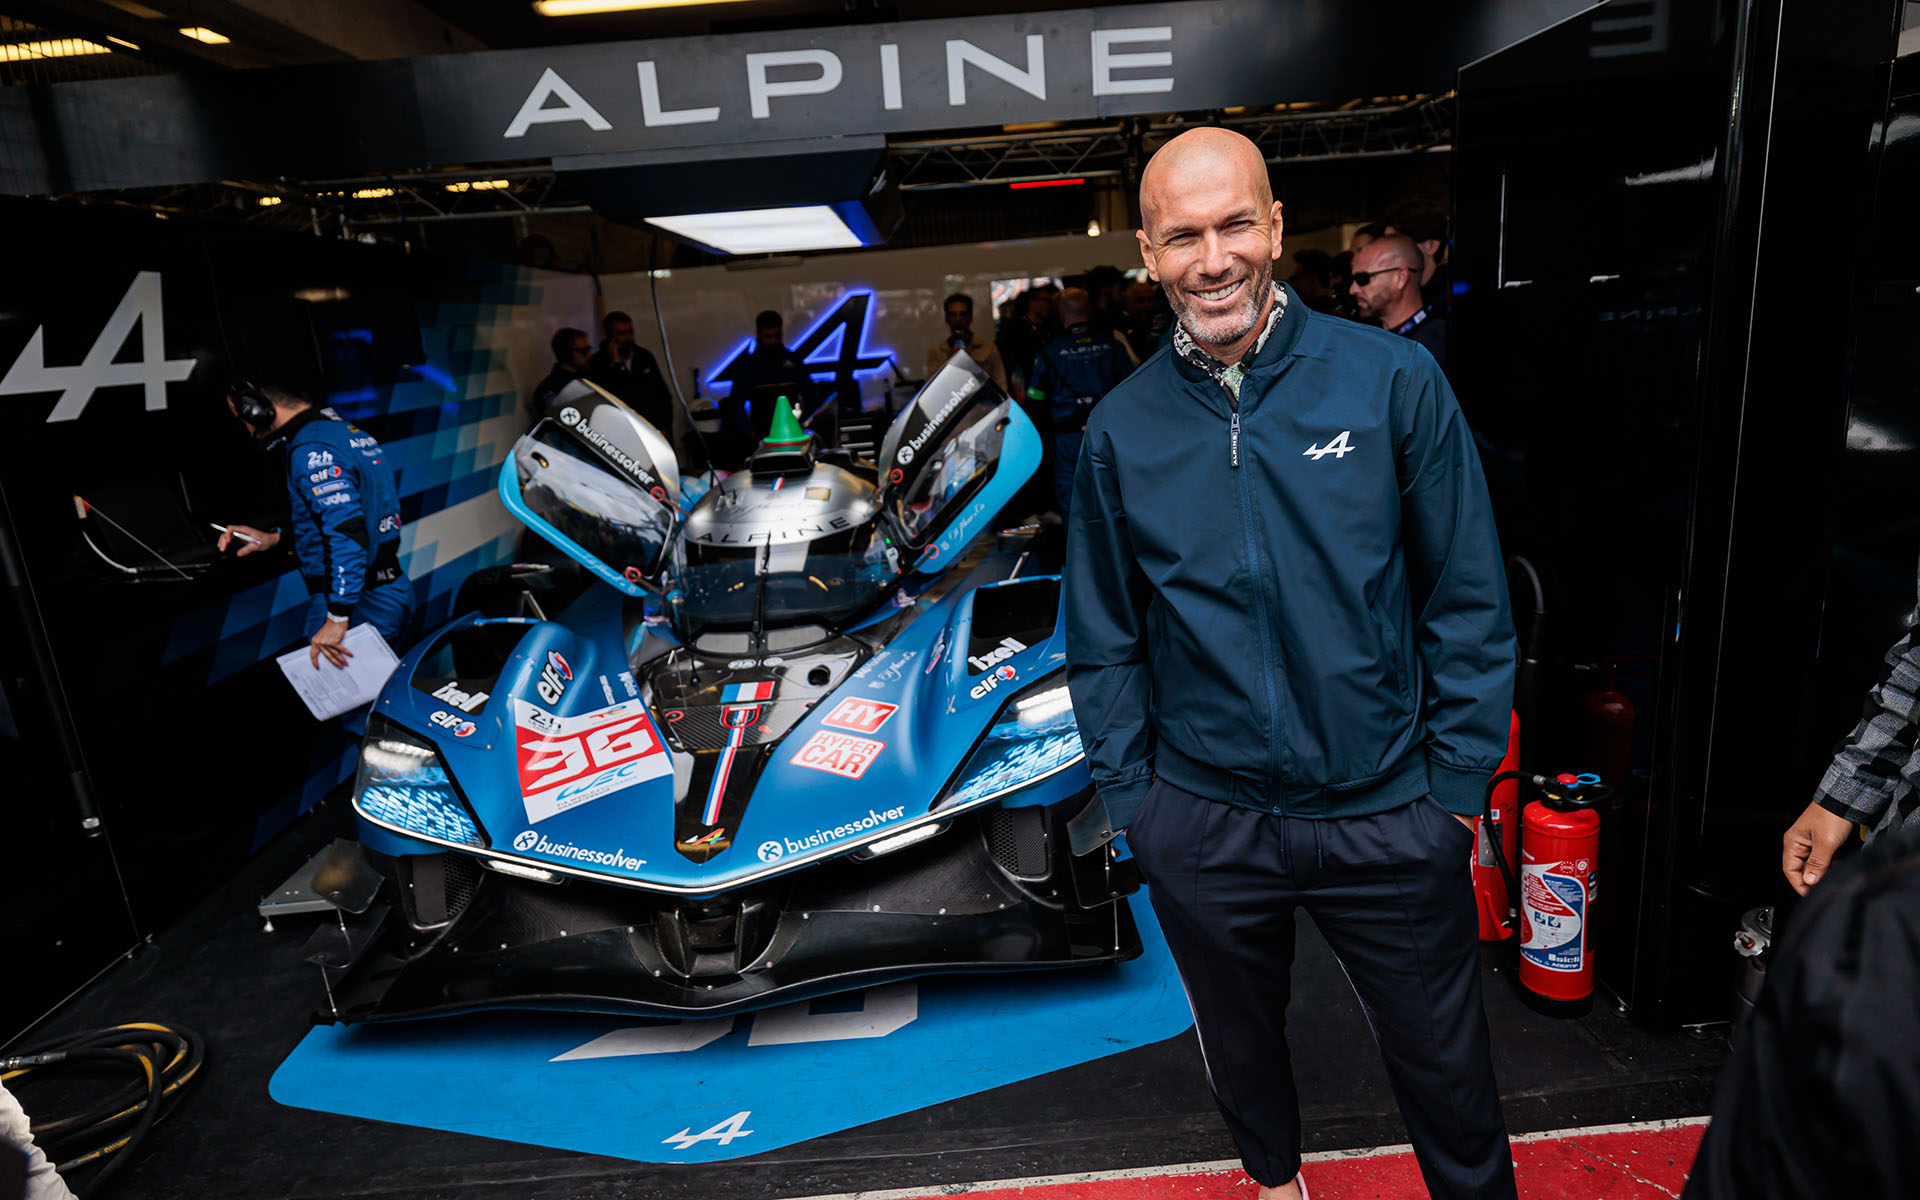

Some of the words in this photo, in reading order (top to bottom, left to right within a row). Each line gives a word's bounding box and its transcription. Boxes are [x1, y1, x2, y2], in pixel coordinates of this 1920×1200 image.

[503, 26, 1175, 138] ALPINE
[908, 377, 976, 451] businessolver
[575, 418, 656, 485] businessolver
[696, 516, 851, 543] ALPINE
[967, 636, 1028, 672] ixell
[431, 681, 490, 712] ixell
[536, 662, 566, 706] elf
[969, 673, 999, 700] elf
[430, 710, 465, 729] elf
[831, 701, 892, 727] HY
[800, 744, 867, 774] CAR
[814, 733, 878, 756] HYPER
[784, 805, 905, 854] businessolver
[534, 835, 647, 871] businessolver
